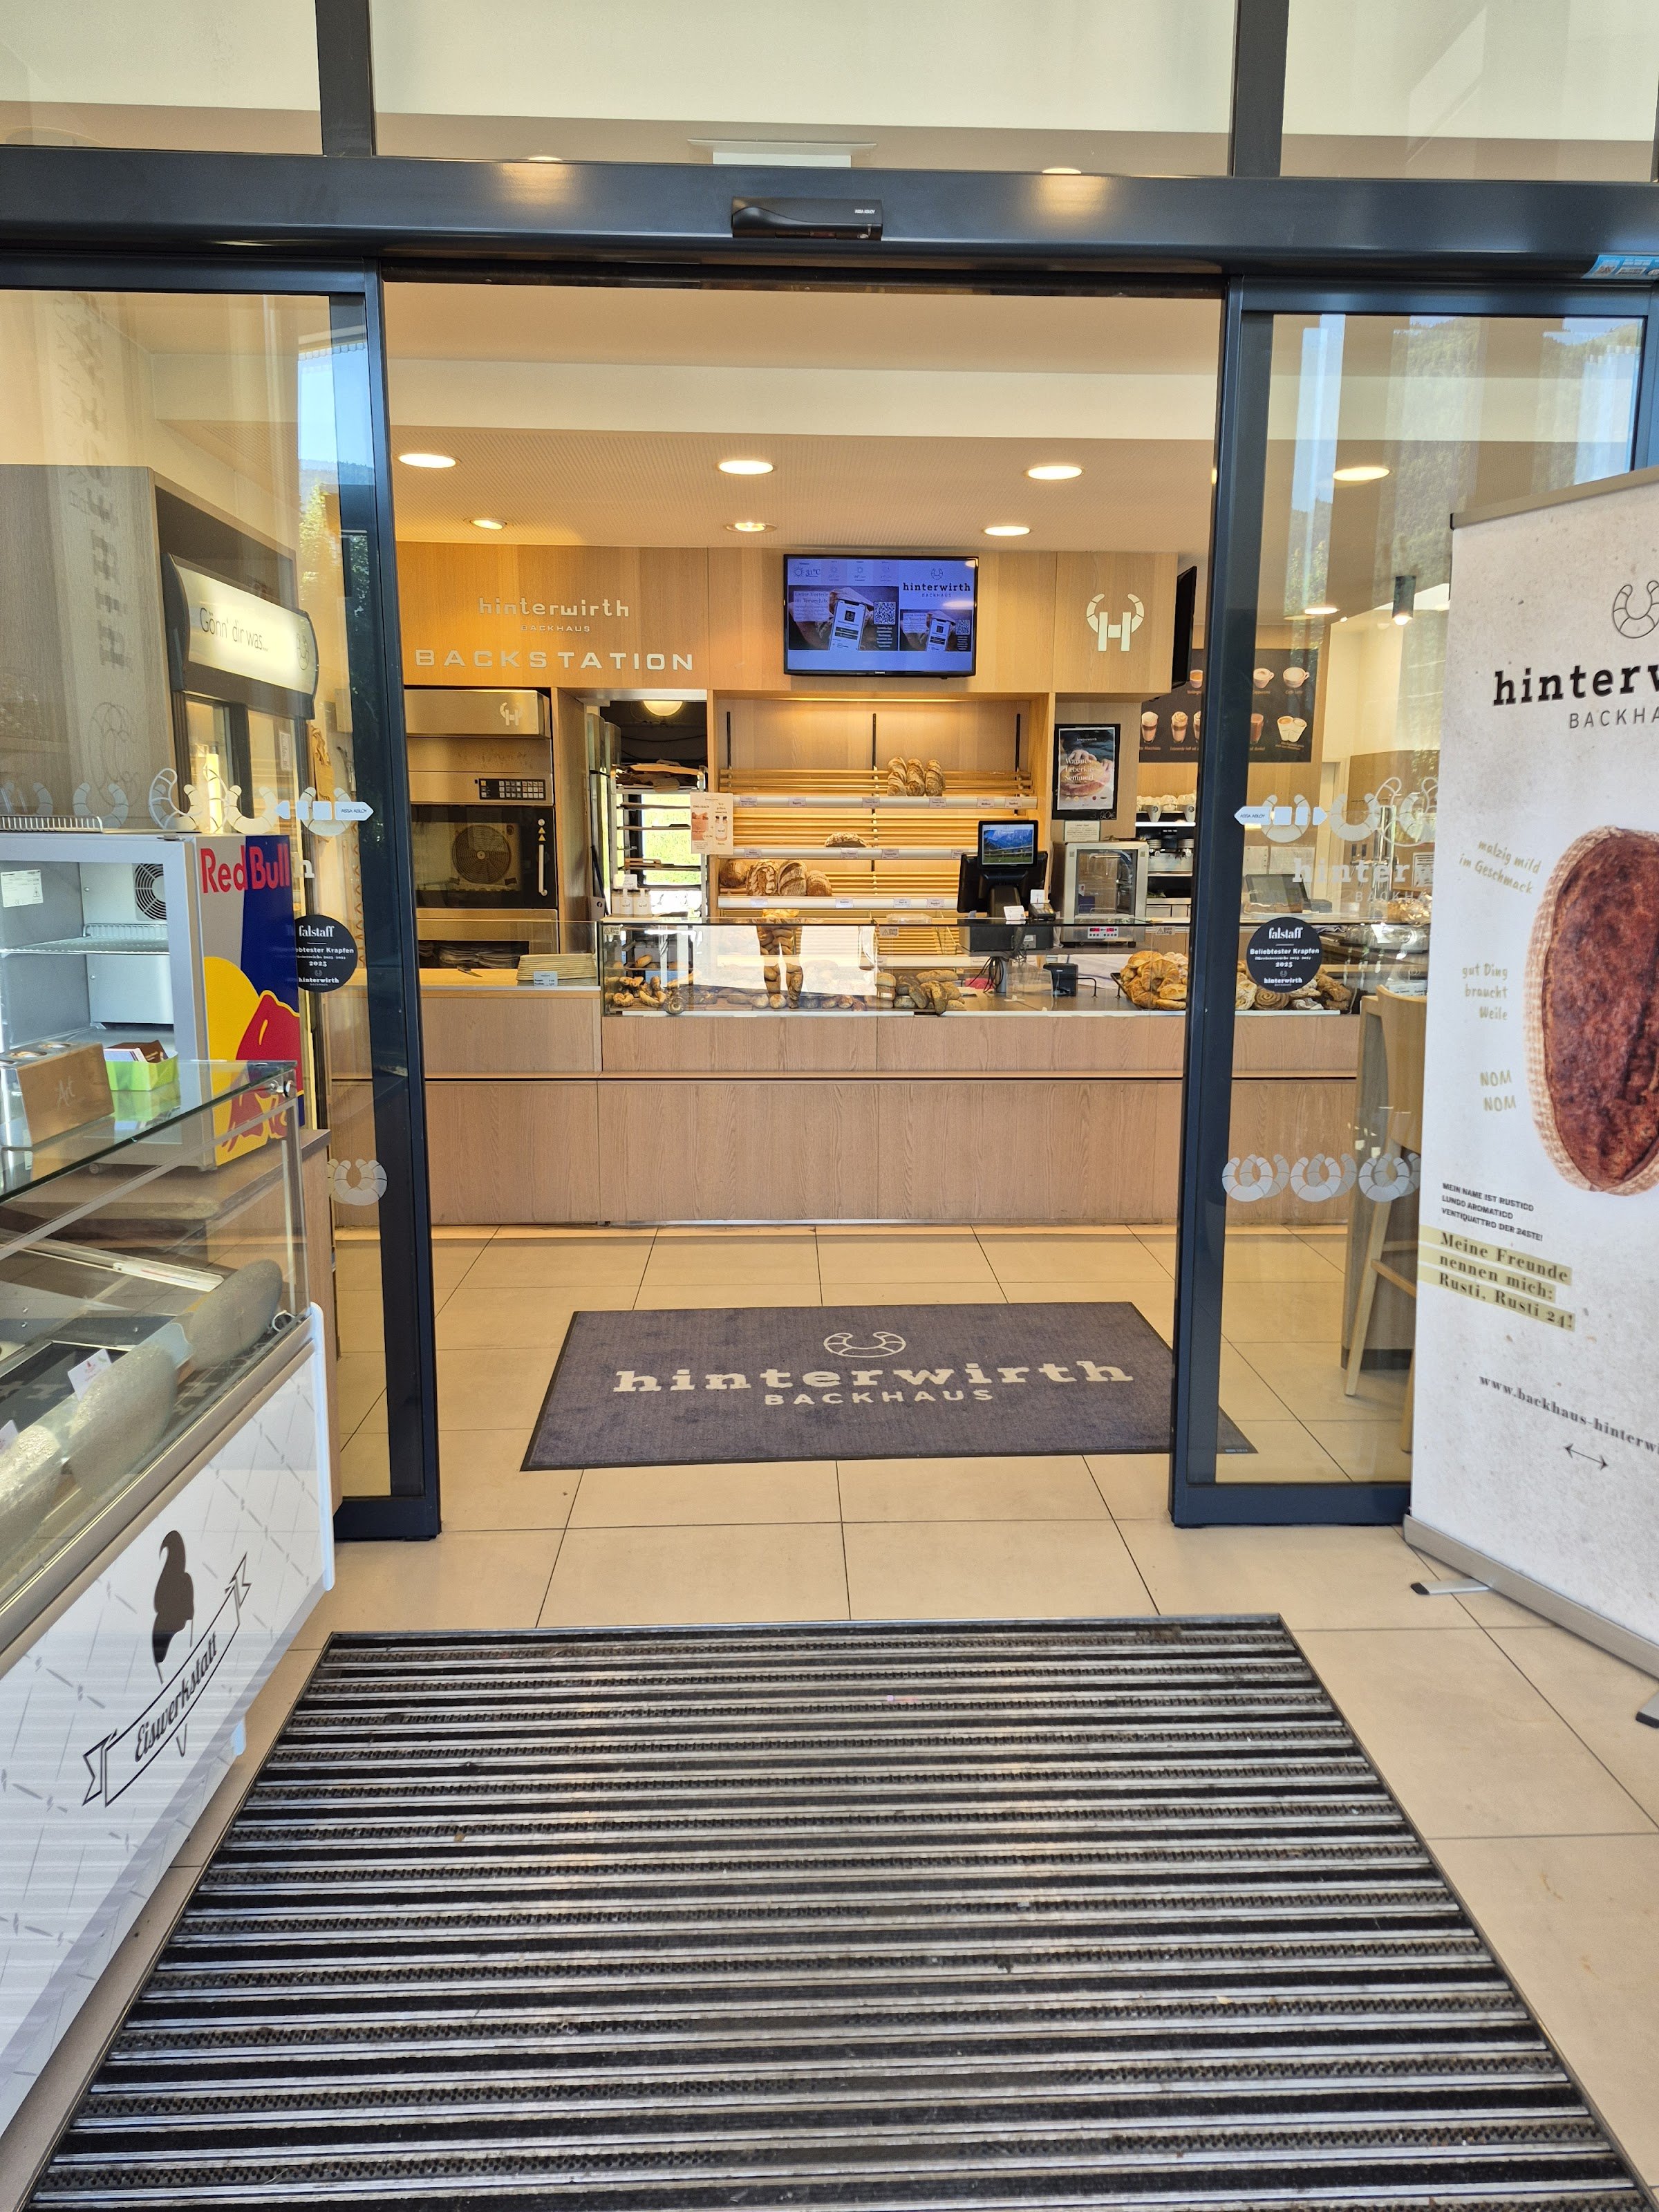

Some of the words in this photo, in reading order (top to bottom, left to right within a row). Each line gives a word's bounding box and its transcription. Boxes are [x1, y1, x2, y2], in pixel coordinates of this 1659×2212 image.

[903, 582, 971, 592] hinterwirth
[478, 597, 629, 617] hinterwirth
[199, 607, 229, 639] Gönn'
[232, 619, 244, 644] dir
[415, 648, 693, 671] BACKSTATION
[200, 845, 248, 894] Red
[249, 843, 290, 890] Bull
[1292, 857, 1411, 883] hinter
[1479, 841, 1512, 865] malzig
[1514, 857, 1541, 874] mild
[1459, 853, 1472, 868] im
[1474, 860, 1533, 894] Geschmack
[299, 925, 335, 937] falstaff
[1268, 926, 1303, 939] falstaff
[1462, 964, 1480, 979] gut
[1483, 963, 1508, 980] Ding
[1465, 984, 1508, 998] braucht
[1479, 1006, 1508, 1020] Weile
[1479, 1070, 1512, 1087] NOM
[1483, 1095, 1517, 1112] NOM
[1441, 1194, 1466, 1208] LUNGO
[1467, 1202, 1513, 1219] AROMATICO
[1442, 1183, 1461, 1193] MEIN
[1463, 1188, 1483, 1199] NAME
[1484, 1194, 1497, 1203] IST
[1499, 1197, 1534, 1212] RUSTICO
[1441, 1208, 1497, 1229] VENTIQUATTRO
[1499, 1223, 1515, 1233] DER
[1441, 1232, 1488, 1258] Meine
[1496, 1248, 1568, 1282] Freunde
[1439, 1255, 1498, 1282] nennen
[1506, 1275, 1553, 1300] mich:
[1438, 1271, 1485, 1300] Rusti.
[1494, 1289, 1539, 1317] Rusti
[1546, 1311, 1573, 1329] 24!
[612, 1359, 1135, 1392] hinterwirth
[765, 1389, 994, 1406] BACKHAUS
[135, 1630, 218, 1762] Eiswerkstatt
